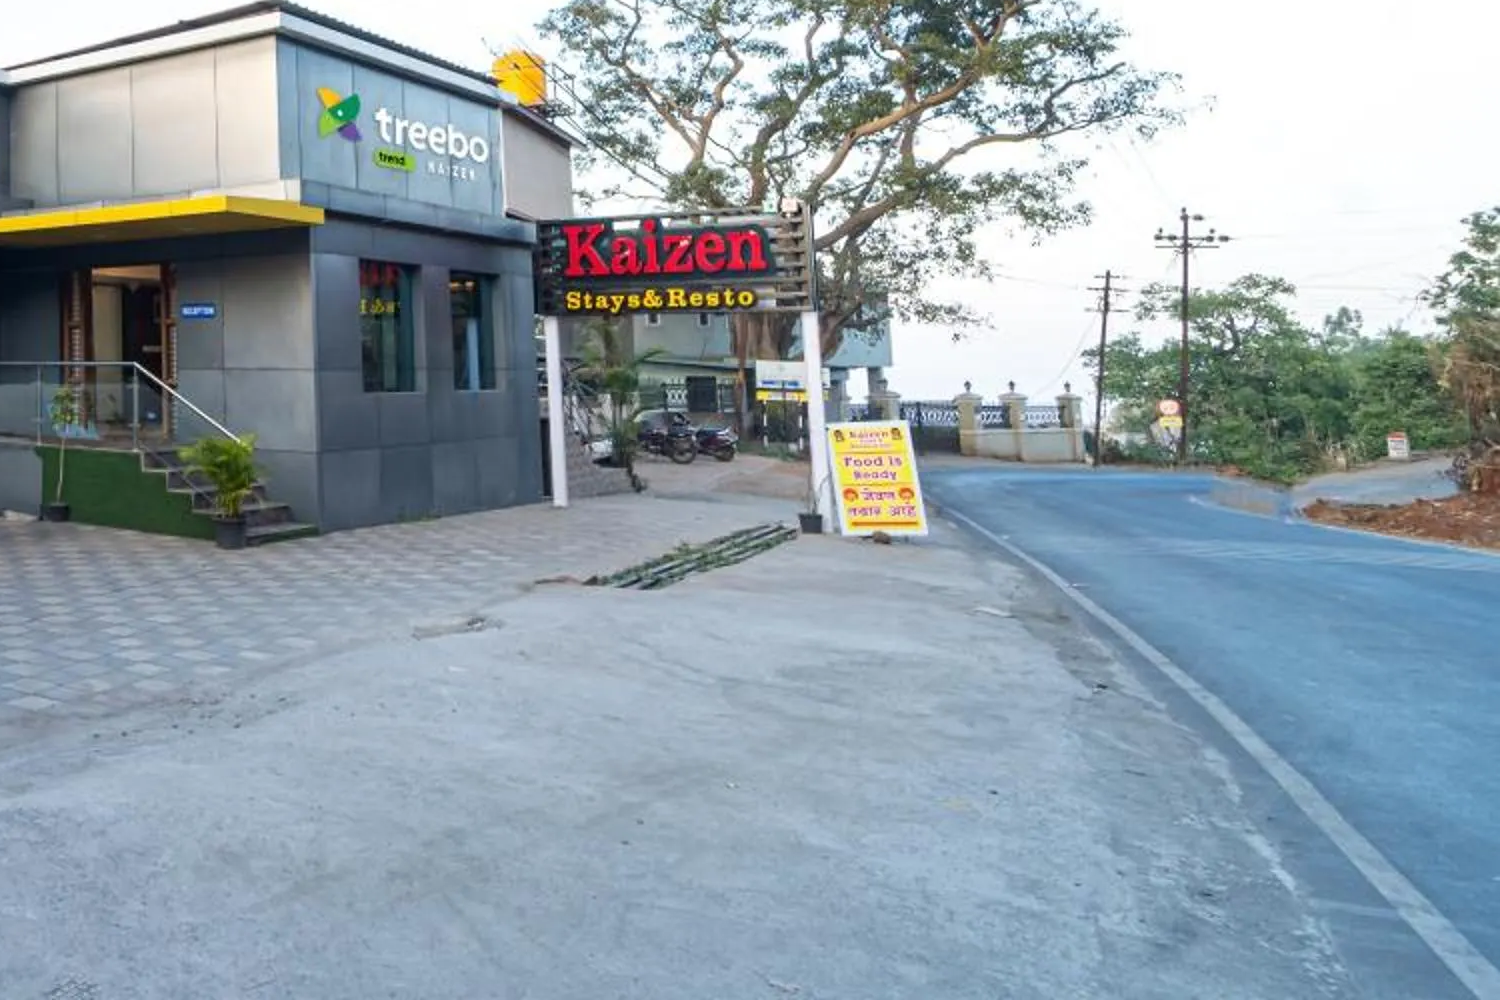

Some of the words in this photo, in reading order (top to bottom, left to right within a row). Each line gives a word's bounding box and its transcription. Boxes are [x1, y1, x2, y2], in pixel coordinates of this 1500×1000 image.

[374, 107, 489, 163] treebo
[378, 151, 406, 166] trend
[562, 219, 769, 277] Kaizen
[844, 455, 884, 467] Food
[853, 470, 897, 481] Ready
